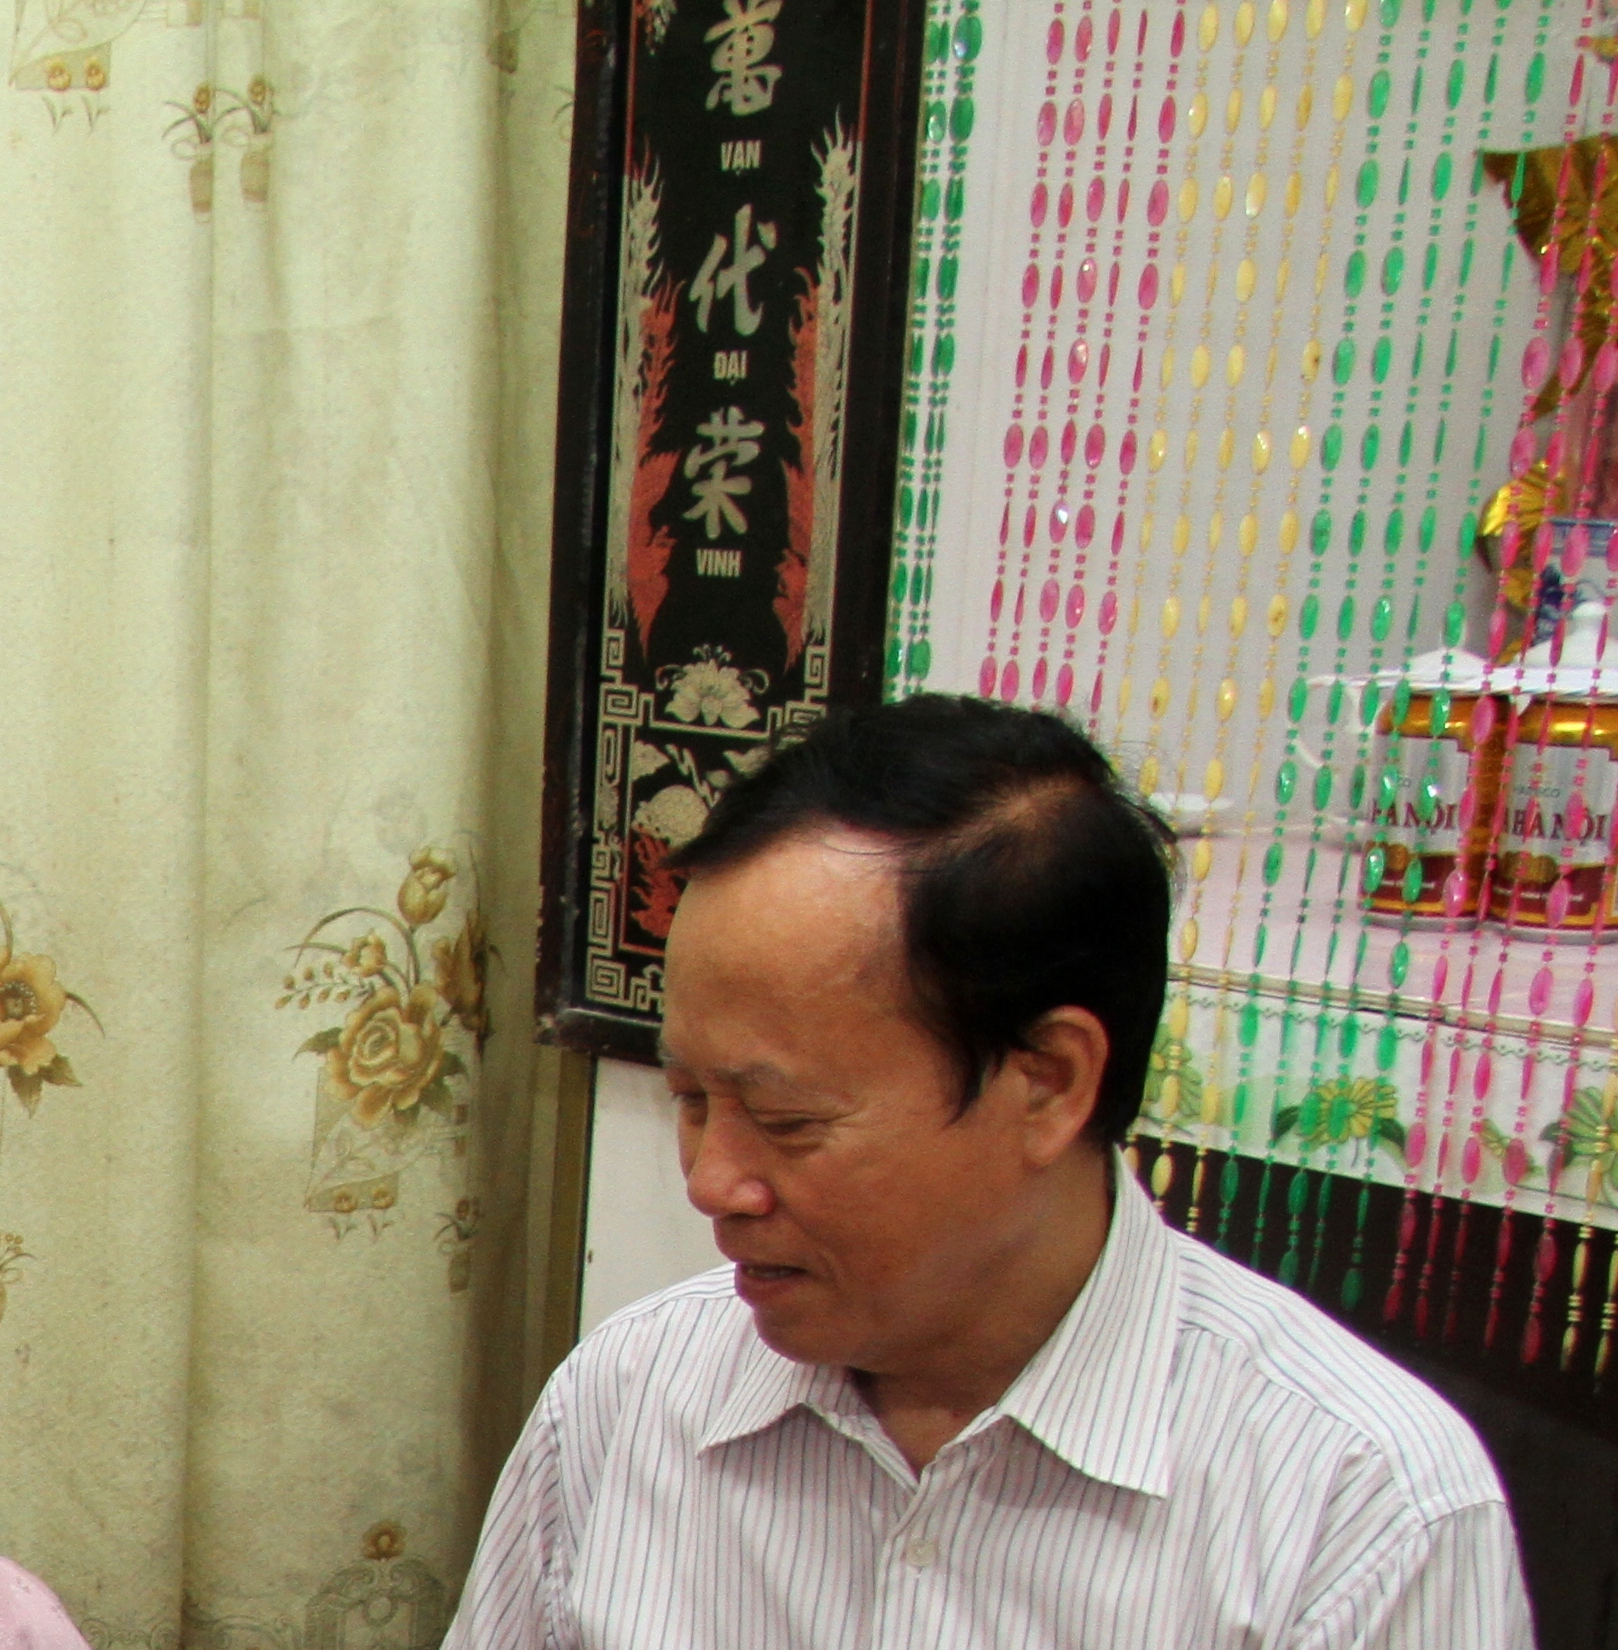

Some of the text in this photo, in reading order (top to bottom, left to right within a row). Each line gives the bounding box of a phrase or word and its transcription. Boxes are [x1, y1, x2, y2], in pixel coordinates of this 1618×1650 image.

[720, 141, 761, 176] VẠN
[689, 203, 777, 338] 代
[713, 350, 748, 386] ĐẠI
[696, 549, 742, 577] VINH
